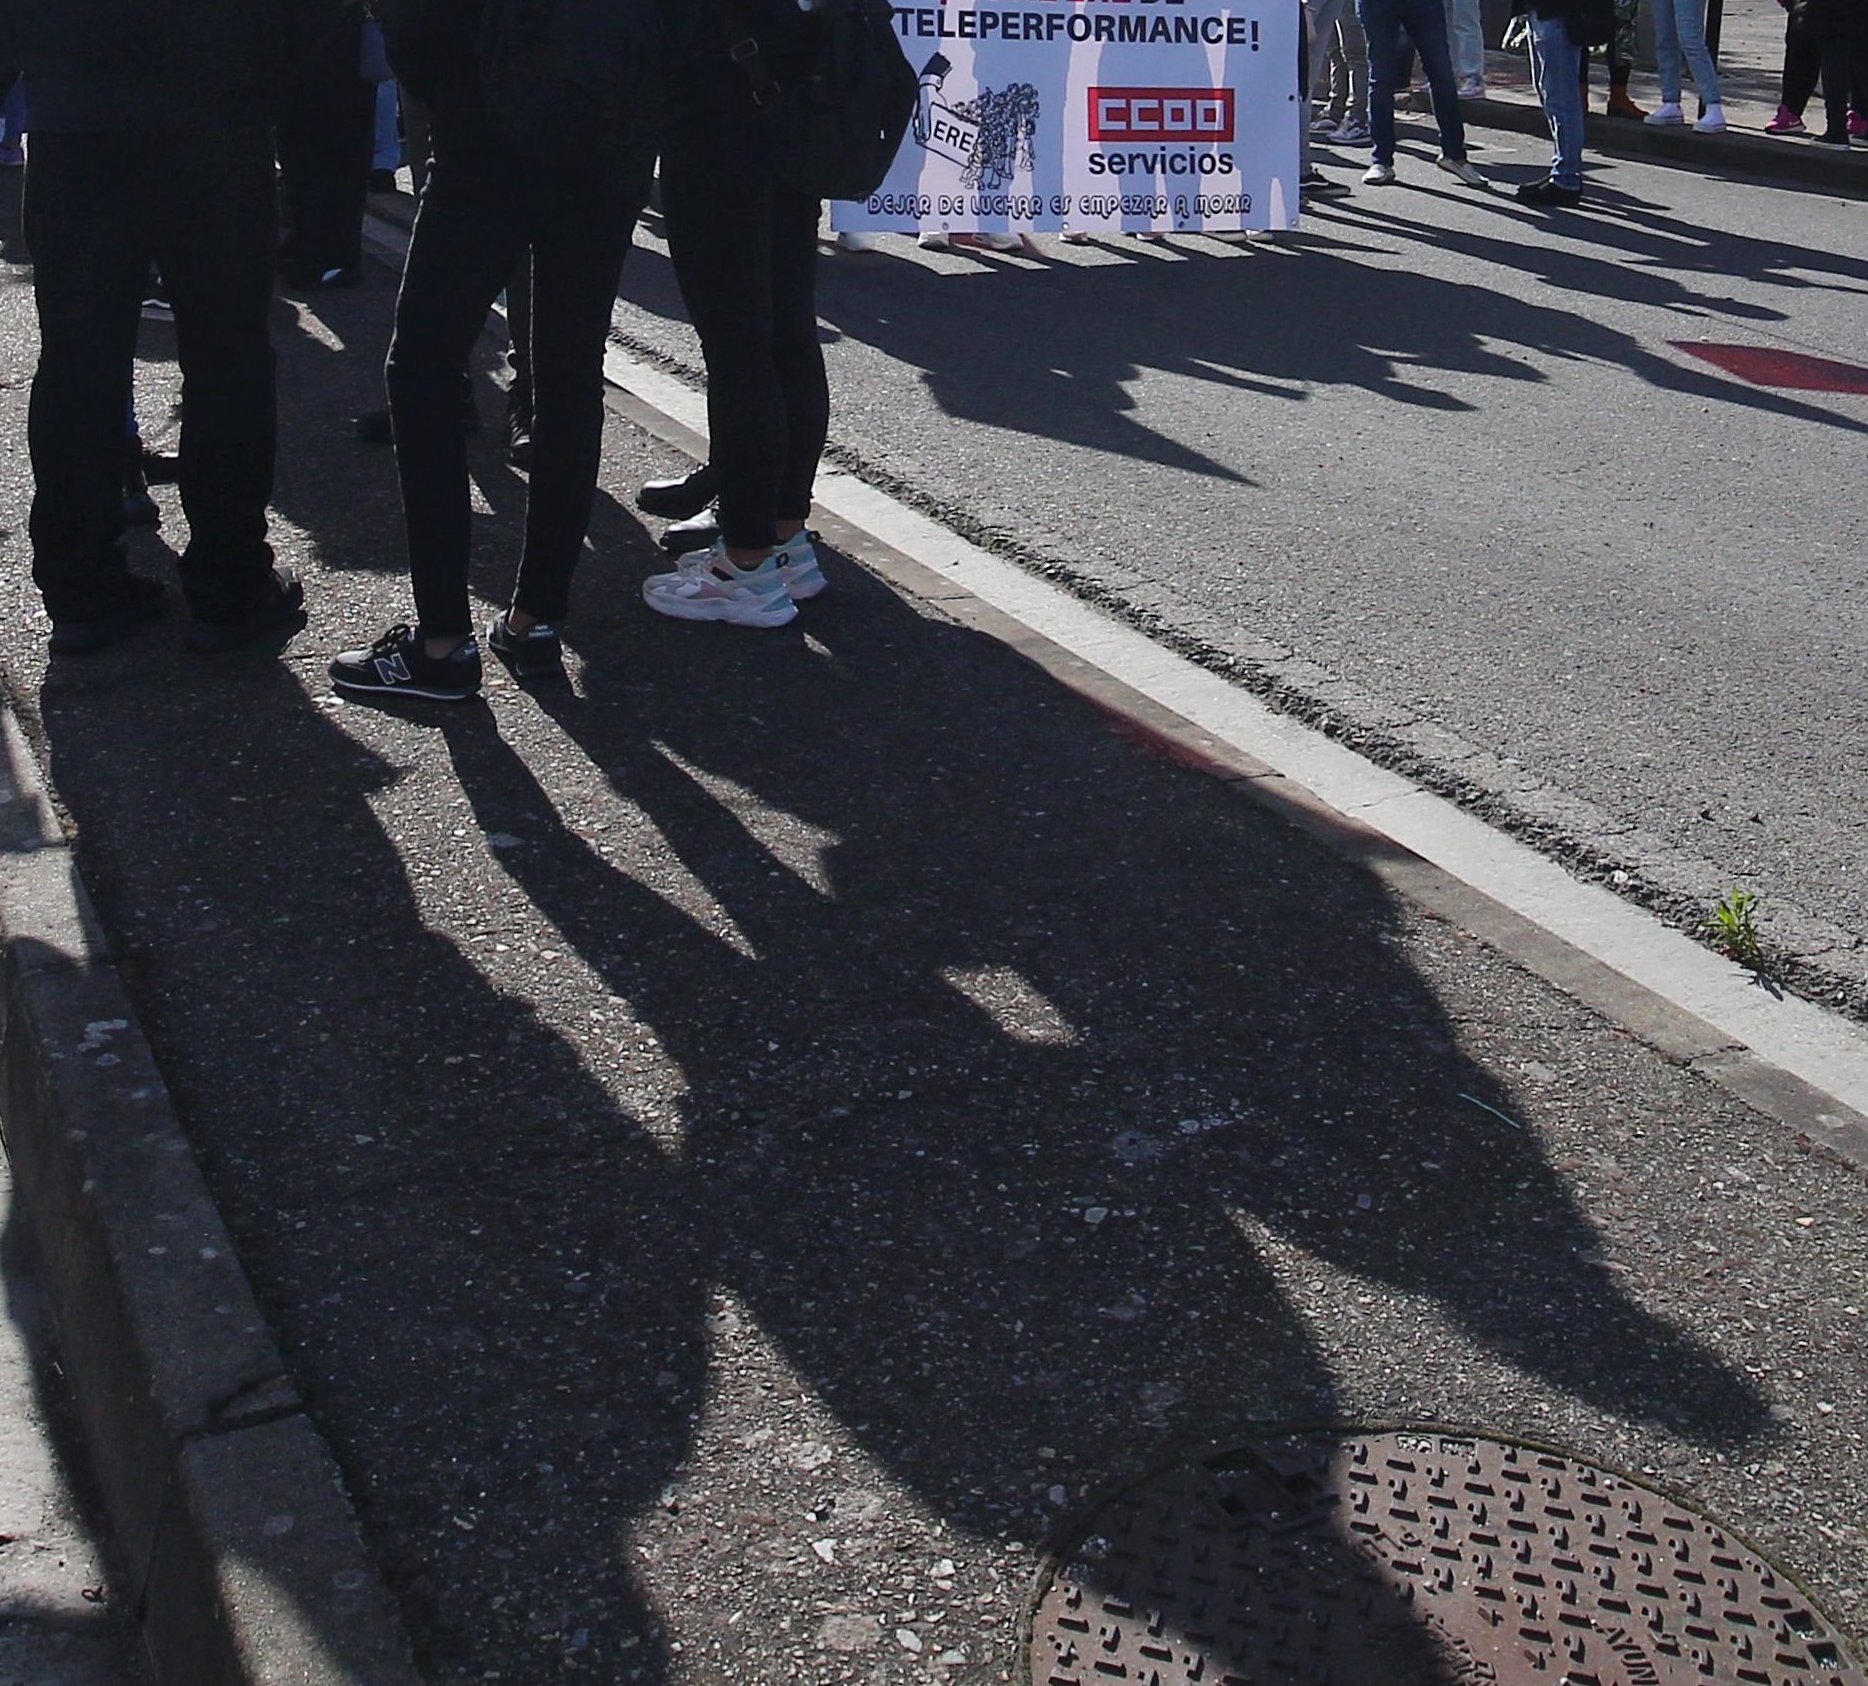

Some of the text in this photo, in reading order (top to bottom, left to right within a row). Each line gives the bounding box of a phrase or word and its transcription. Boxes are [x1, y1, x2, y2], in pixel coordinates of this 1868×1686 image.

[894, 7, 1259, 52] TELEPERFORMANCE!
[1096, 96, 1227, 133] CCOO
[932, 119, 975, 154] ERE
[1088, 146, 1234, 175] servicios
[868, 194, 1253, 220] DEJAR DE LUCHAR ES EMPEZAR A MORIR
